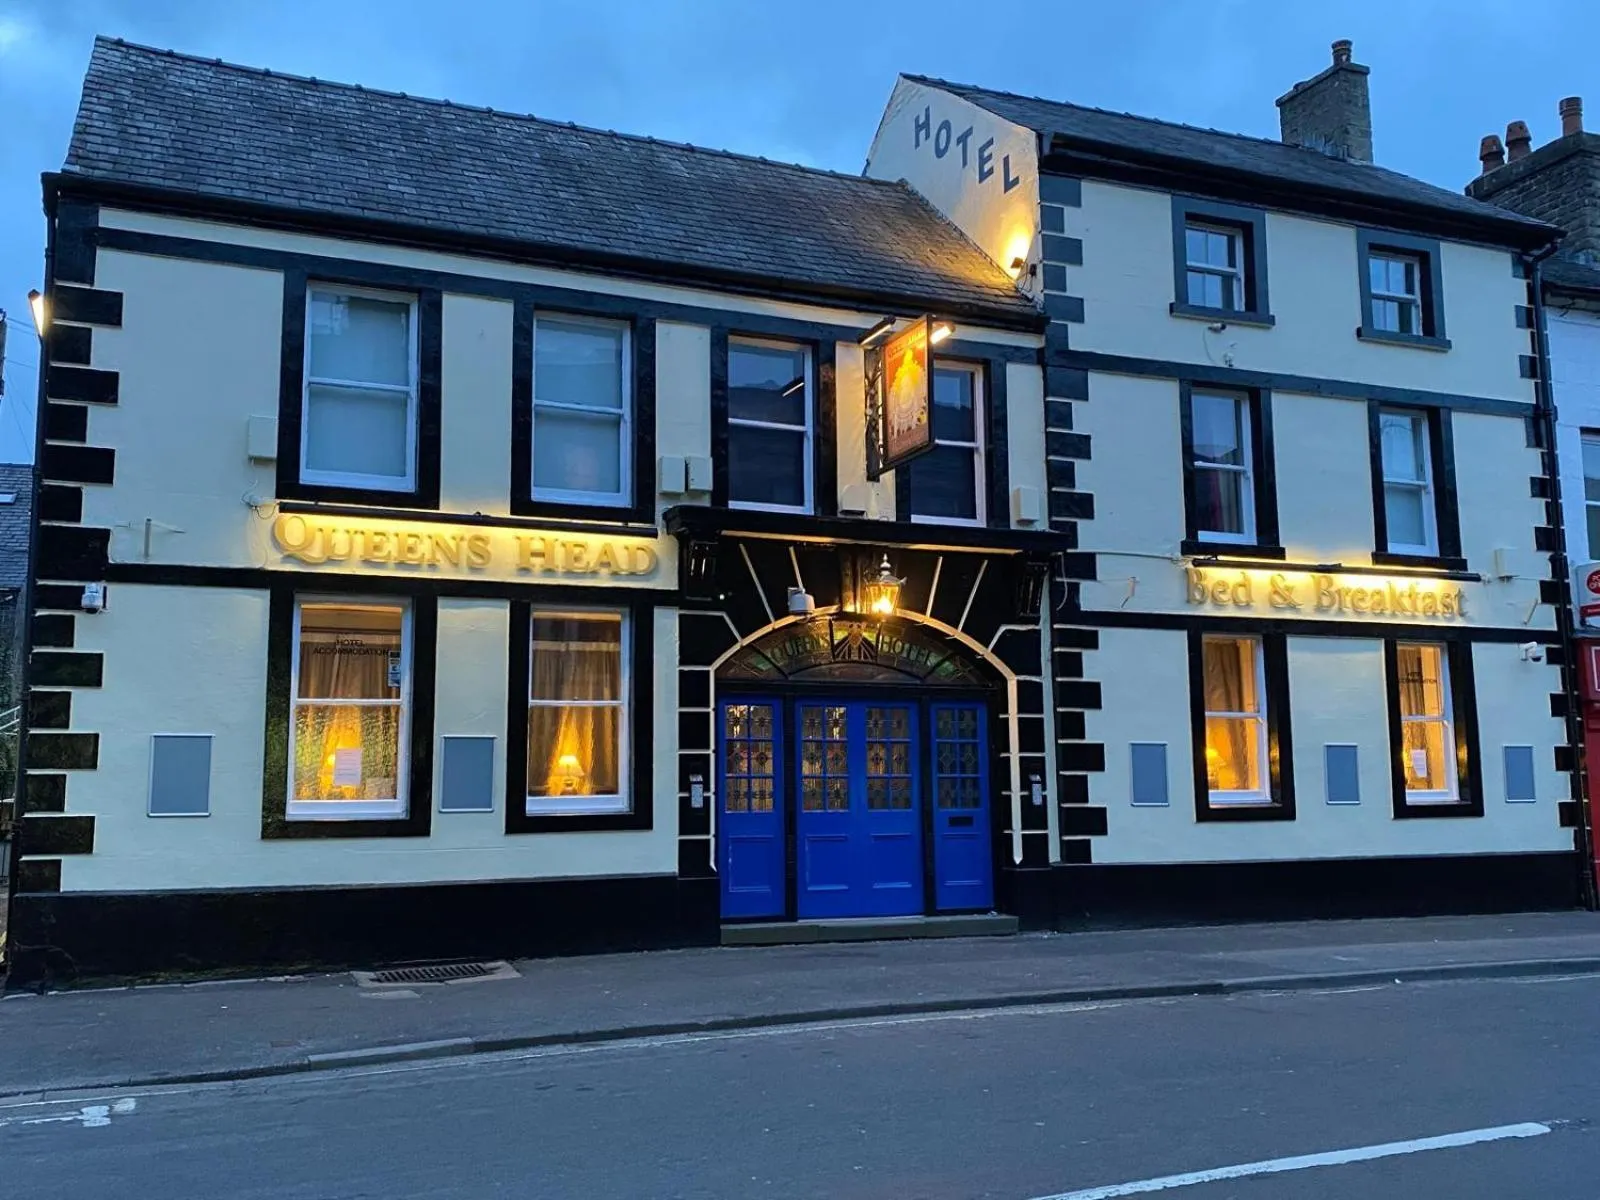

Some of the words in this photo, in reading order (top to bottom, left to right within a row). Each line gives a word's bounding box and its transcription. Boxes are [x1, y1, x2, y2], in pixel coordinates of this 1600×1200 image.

[914, 105, 1020, 194] HOTEL
[272, 515, 493, 566] QUEENS
[515, 535, 657, 576] HEAD
[1186, 568, 1253, 605] Bed
[1270, 574, 1303, 609] &
[1311, 574, 1467, 616] Breakfast
[336, 639, 366, 647] HOTEL
